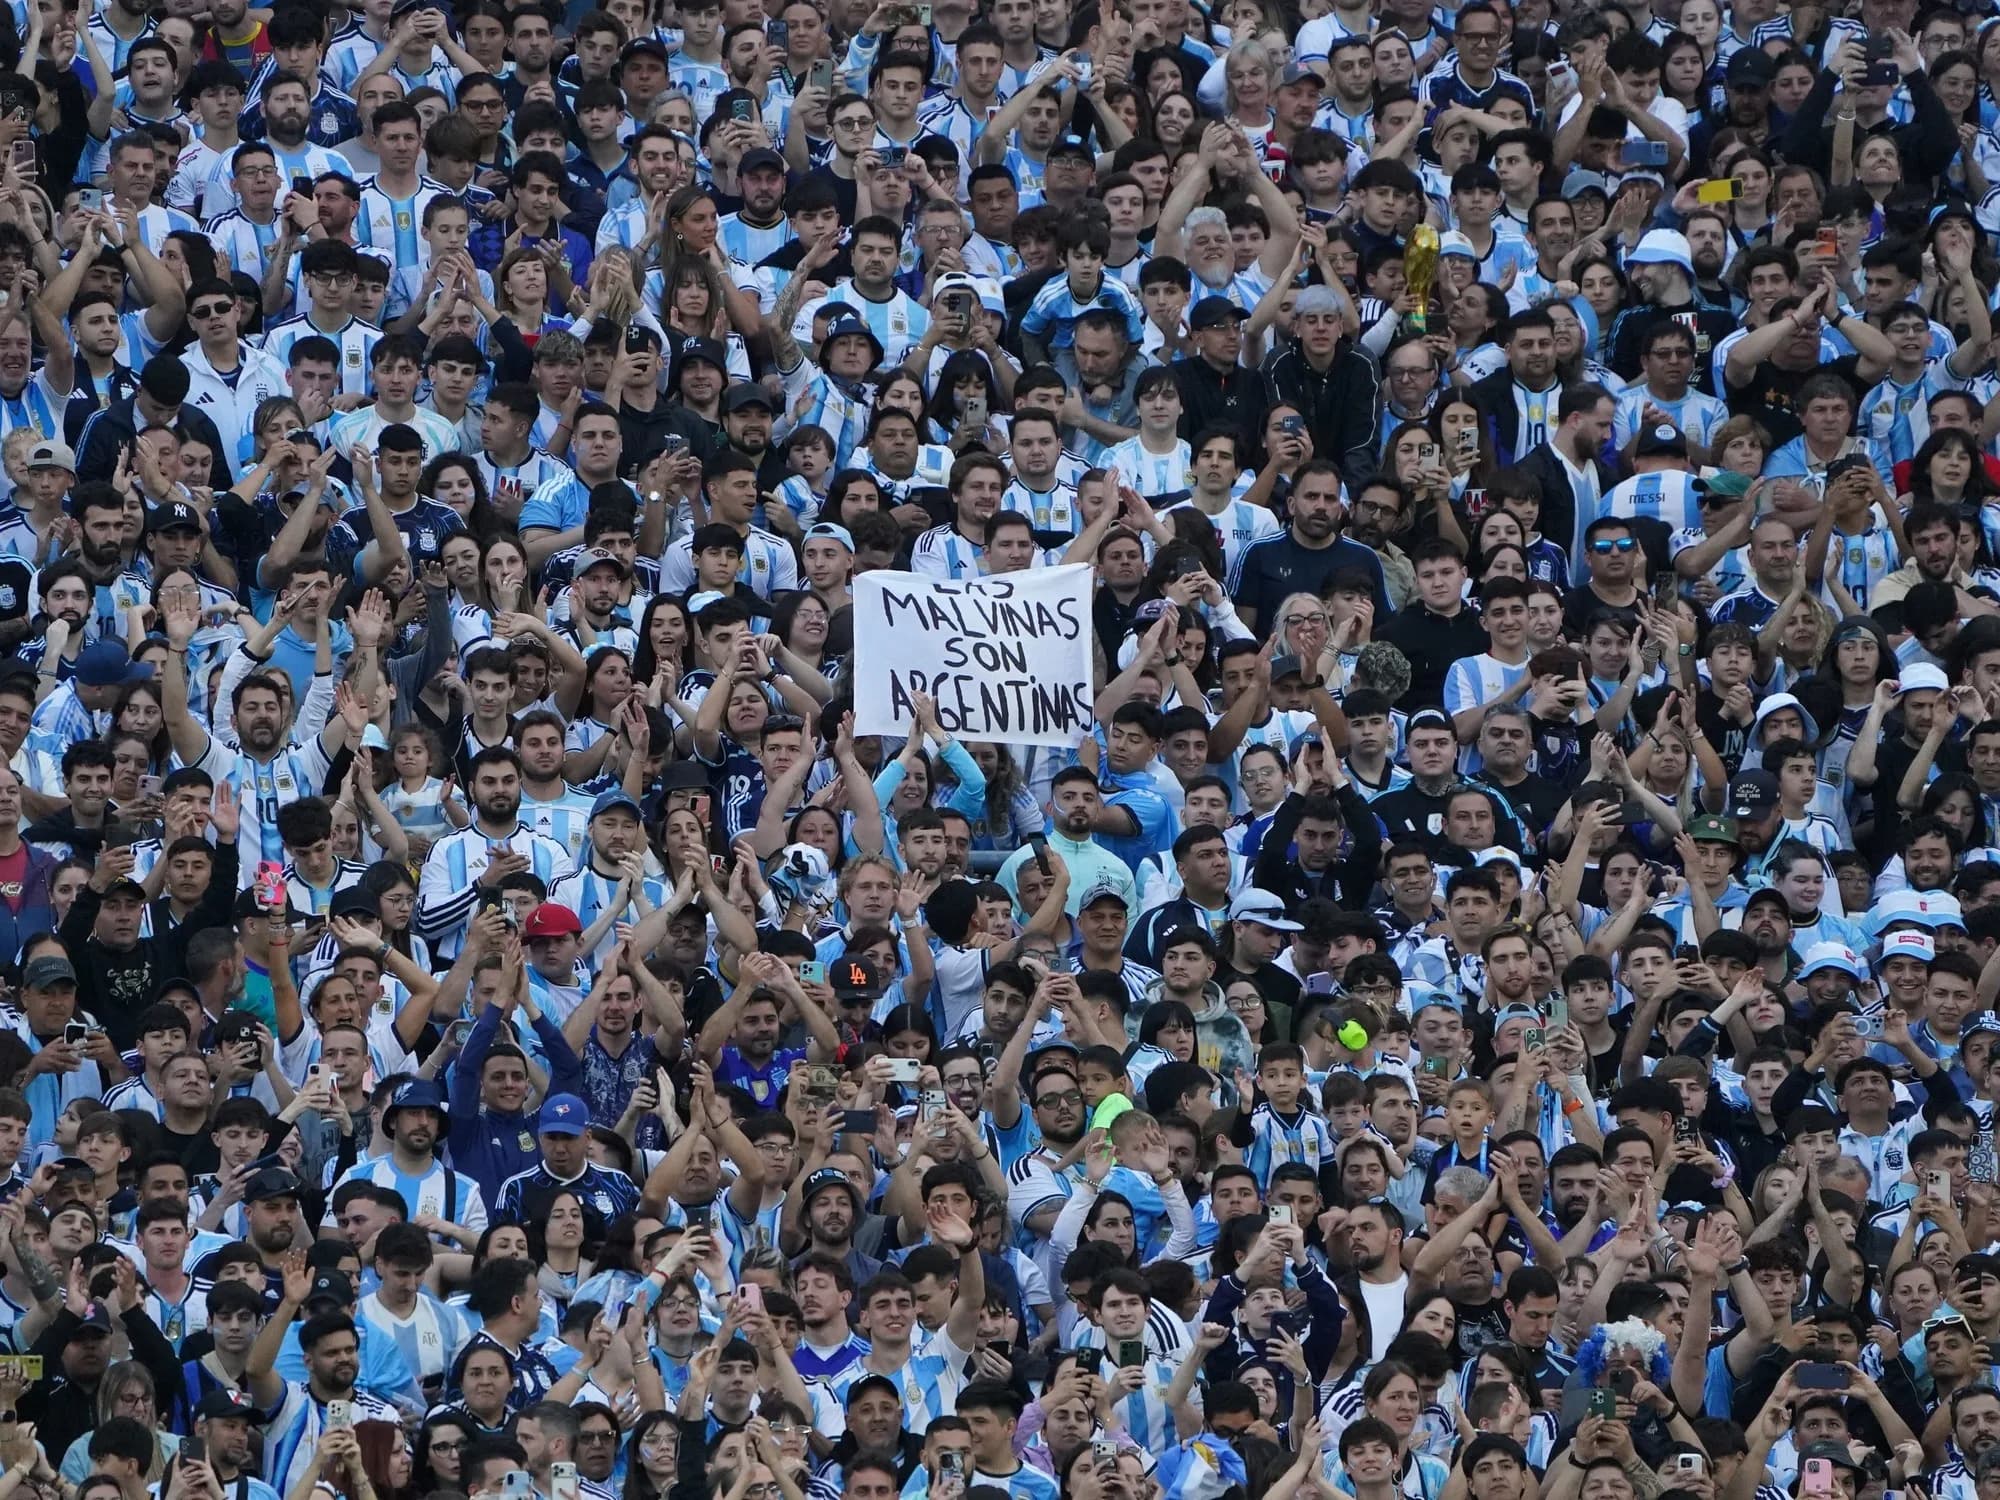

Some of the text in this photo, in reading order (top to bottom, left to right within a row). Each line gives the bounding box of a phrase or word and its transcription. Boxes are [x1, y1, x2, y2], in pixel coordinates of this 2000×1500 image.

[1629, 492, 1666, 505] MESSI
[174, 503, 188, 518] NY
[882, 587, 1080, 640] MALVINAS
[944, 637, 1027, 673] SON
[728, 774, 751, 797] 19
[849, 963, 867, 984] LA
